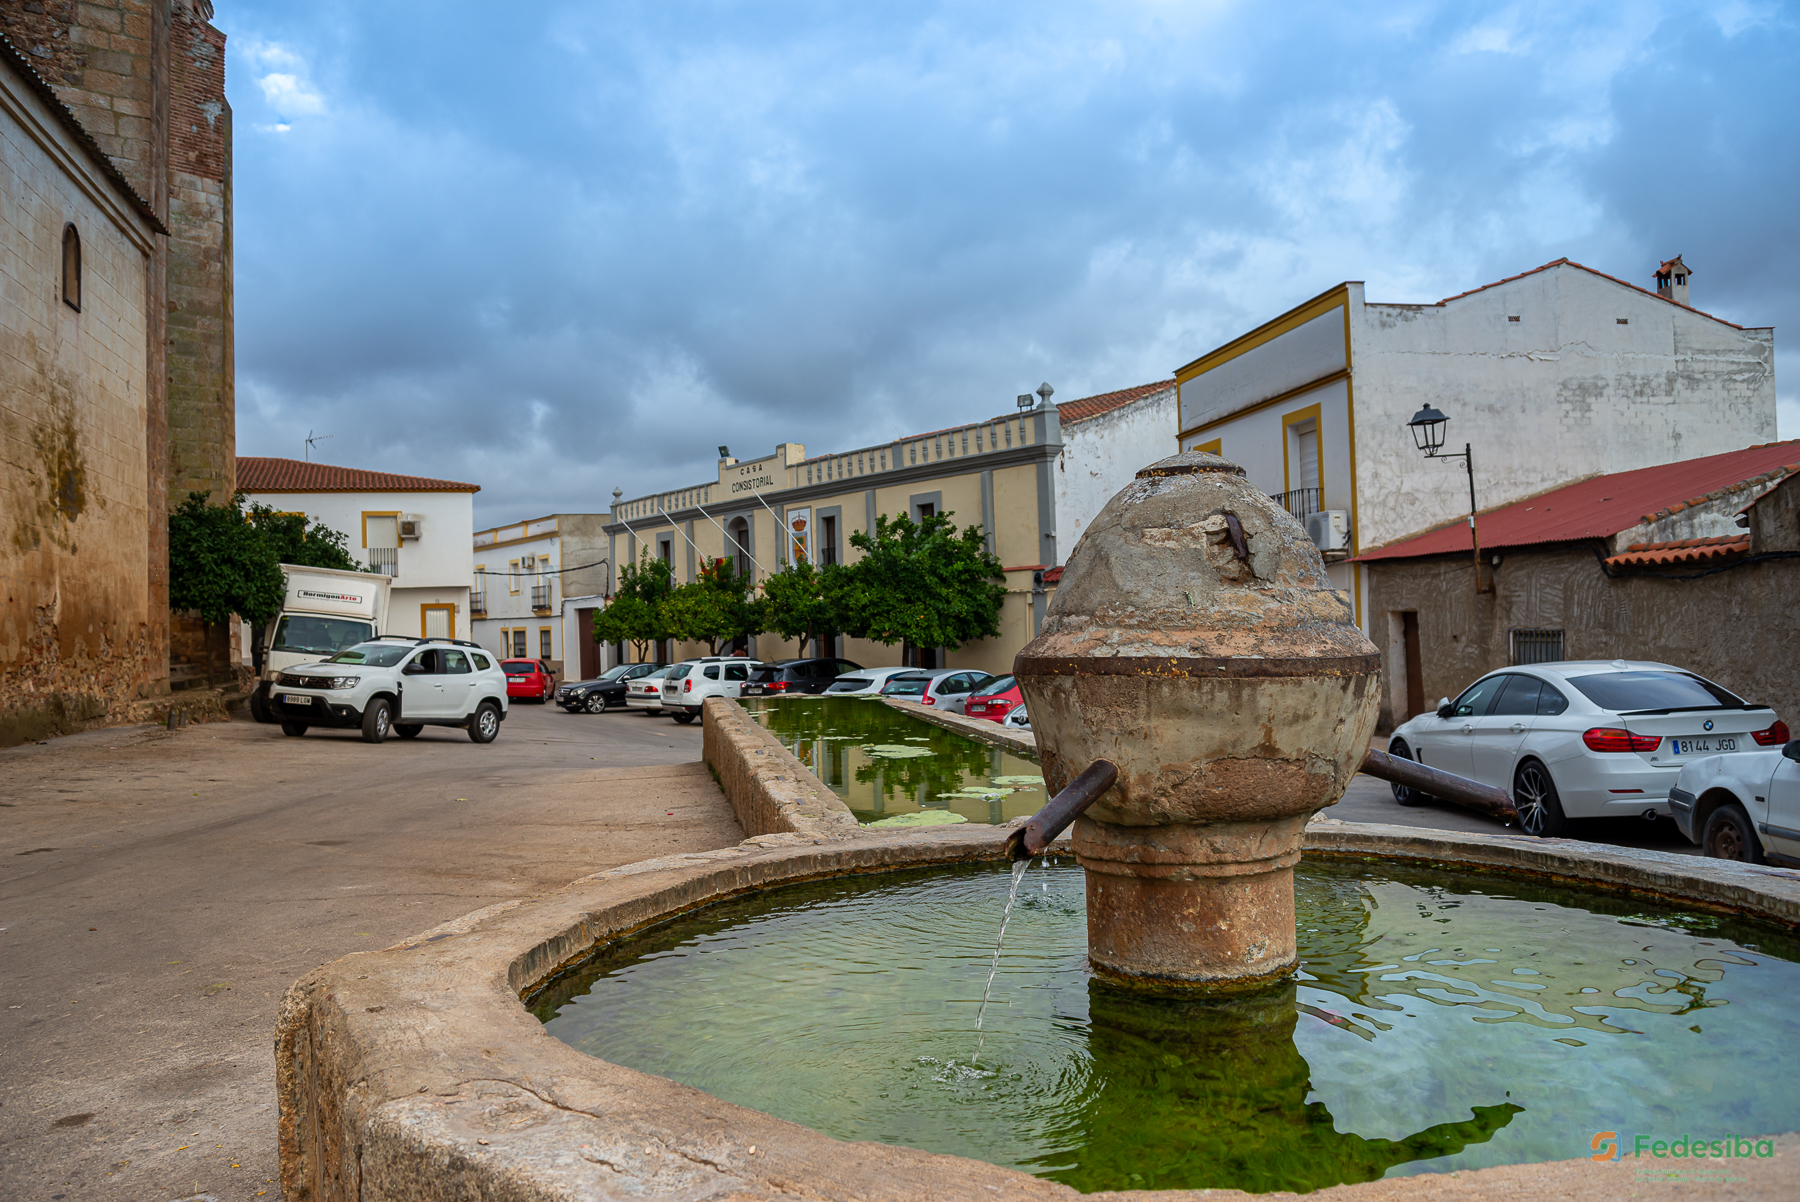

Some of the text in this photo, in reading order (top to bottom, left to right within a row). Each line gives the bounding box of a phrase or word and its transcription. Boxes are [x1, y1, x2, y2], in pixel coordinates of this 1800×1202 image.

[740, 464, 763, 475] CASA
[731, 475, 774, 493] CONSISTORIAL
[1681, 739, 1736, 753] 8144 JGD
